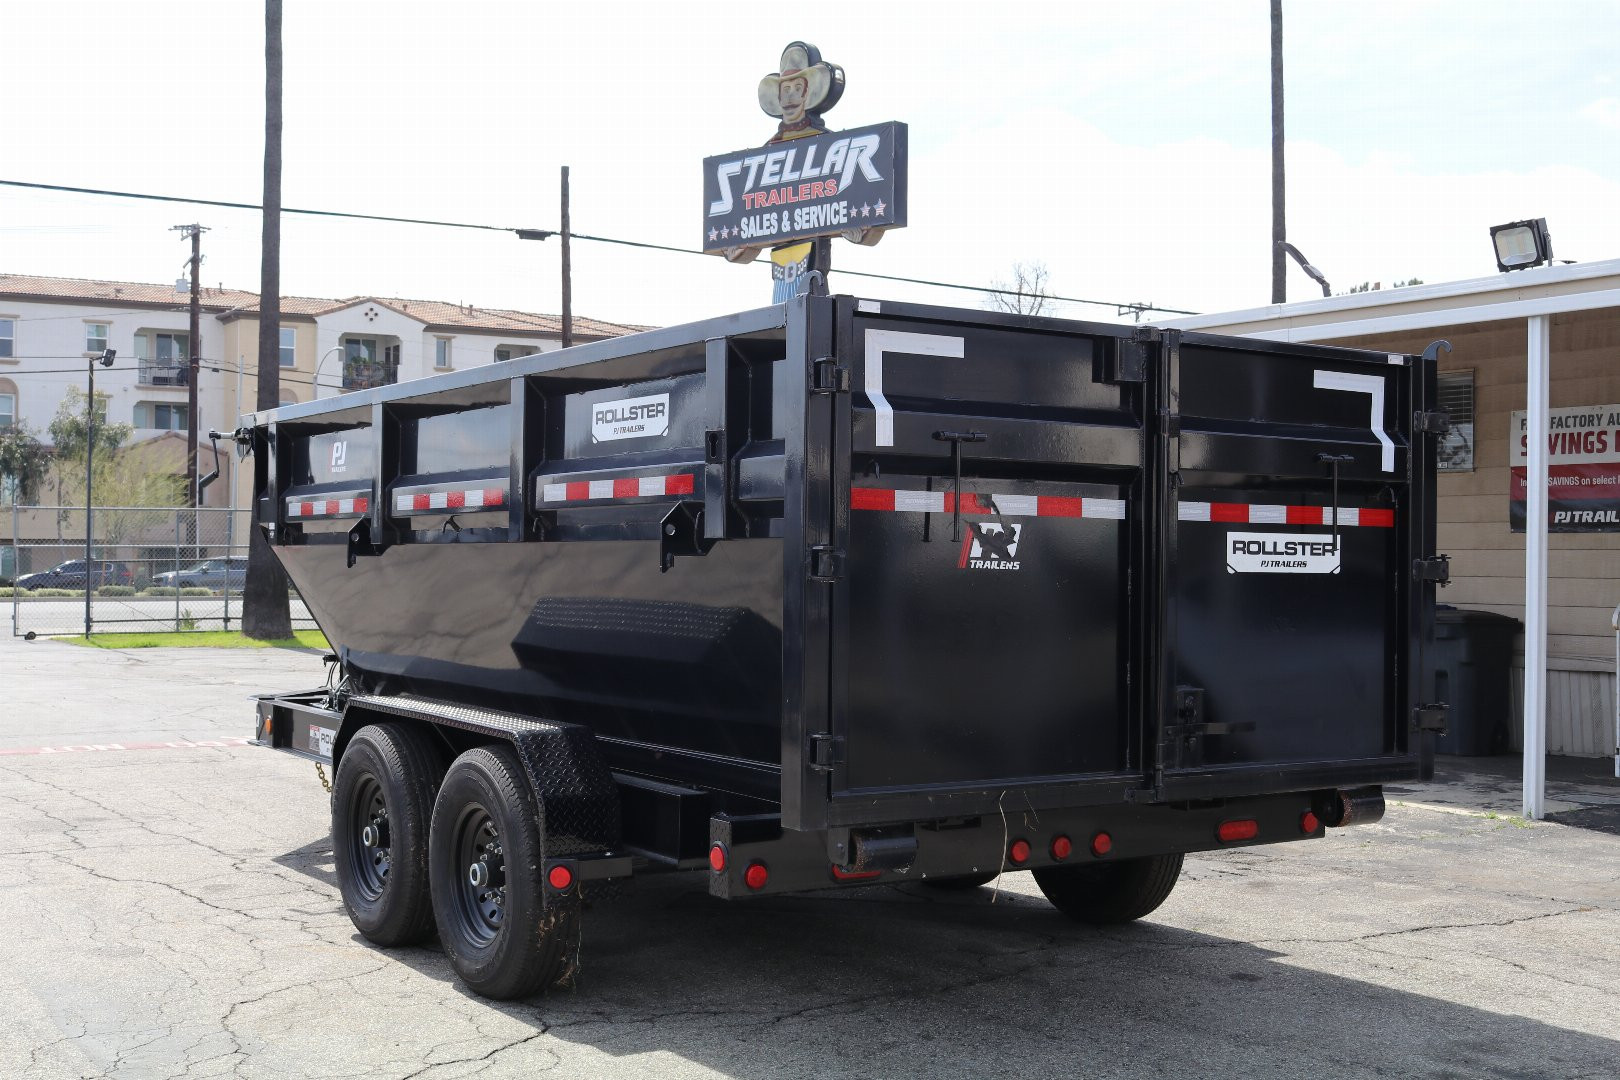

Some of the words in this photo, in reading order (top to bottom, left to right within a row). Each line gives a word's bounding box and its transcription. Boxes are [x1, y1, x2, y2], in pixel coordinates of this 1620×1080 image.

[708, 134, 884, 217] STELLAR
[742, 179, 838, 210] TRAILERS
[740, 213, 778, 239] SALES
[782, 210, 791, 232] &
[793, 201, 847, 231] SERVICE
[596, 402, 666, 425] ROLLSTER
[1550, 413, 1604, 430] FACTORY
[619, 424, 645, 434] TRAILERS
[331, 441, 347, 466] PJ
[1520, 430, 1608, 457] SVINGS
[1547, 476, 1580, 486] SAVINGS
[1581, 477, 1591, 486] on
[1592, 475, 1617, 485] select
[1232, 540, 1335, 556] ROLLSTER
[1270, 560, 1307, 568] TRAILERS
